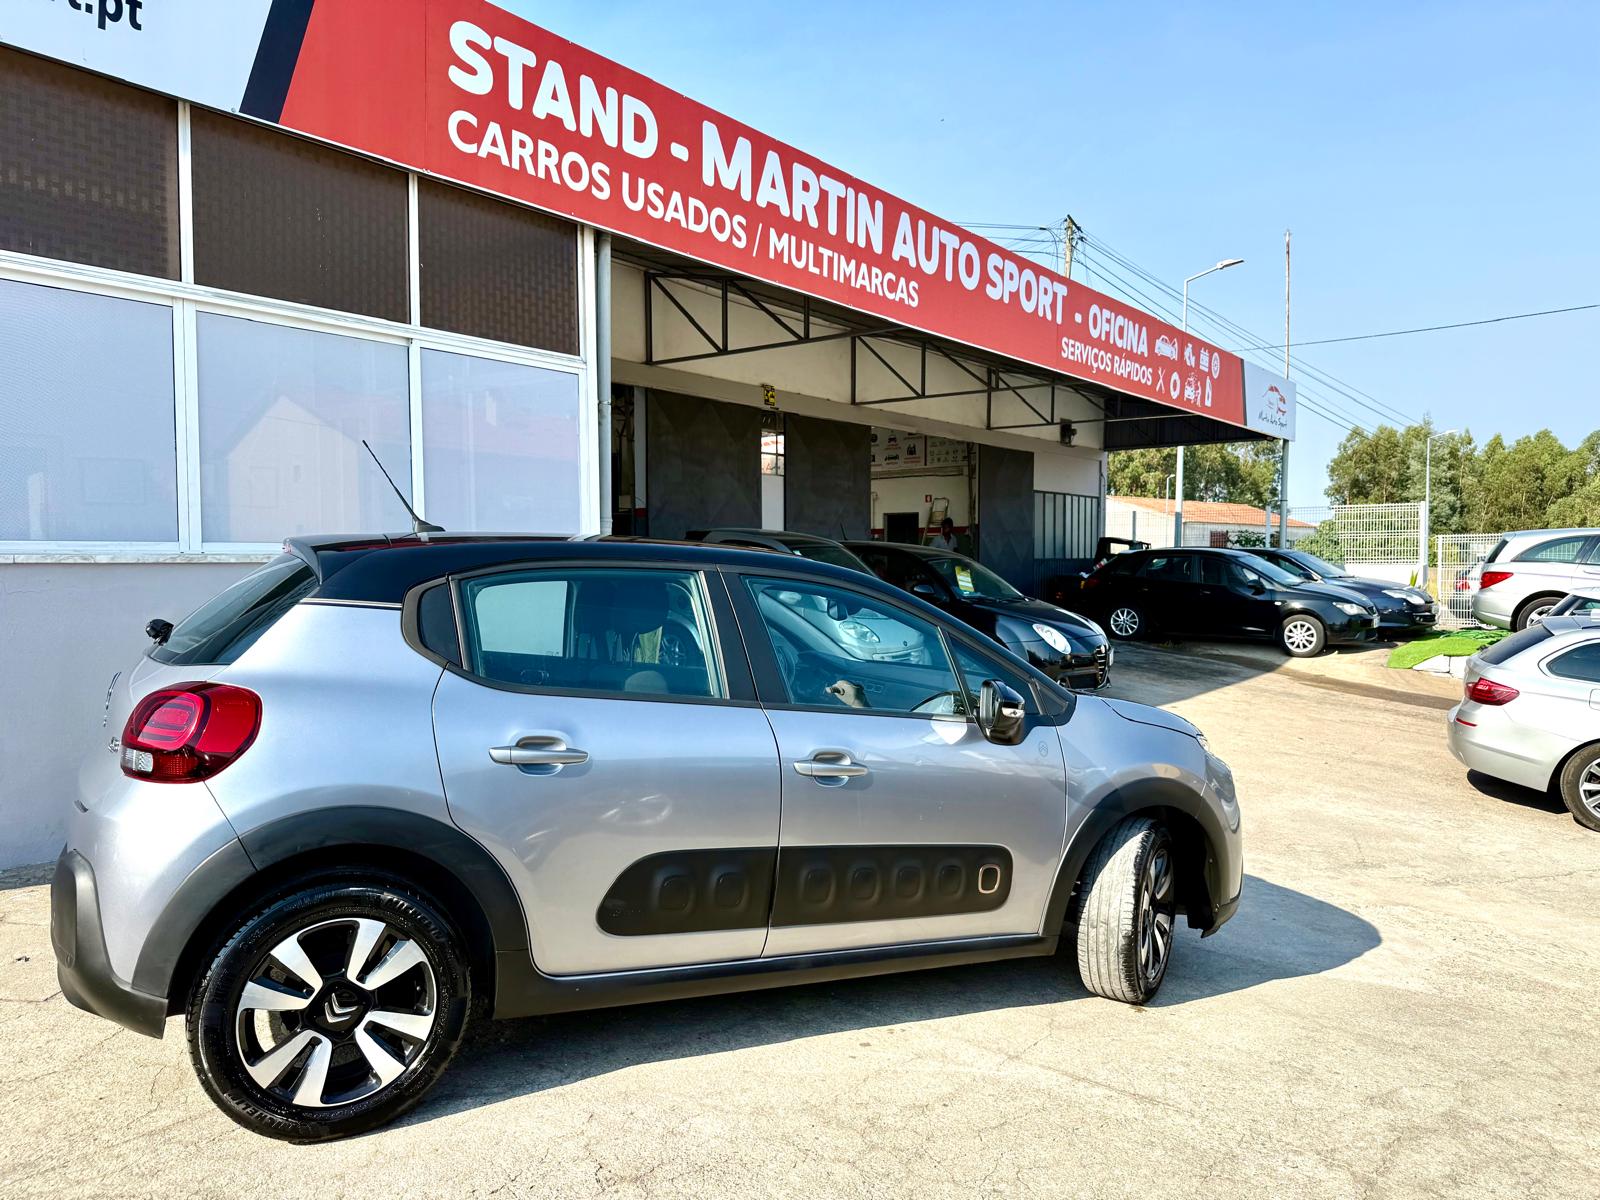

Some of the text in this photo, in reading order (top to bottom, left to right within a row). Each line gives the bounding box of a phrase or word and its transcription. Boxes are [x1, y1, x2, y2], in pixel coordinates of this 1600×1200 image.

[448, 21, 1149, 358] STAND - MARTIN AUTO SPORT - OFICINA
[448, 110, 919, 308] CARROS USADOS / MULTIMARCAS
[1061, 336, 1154, 387] SERVIÇOS RÁPIDOS
